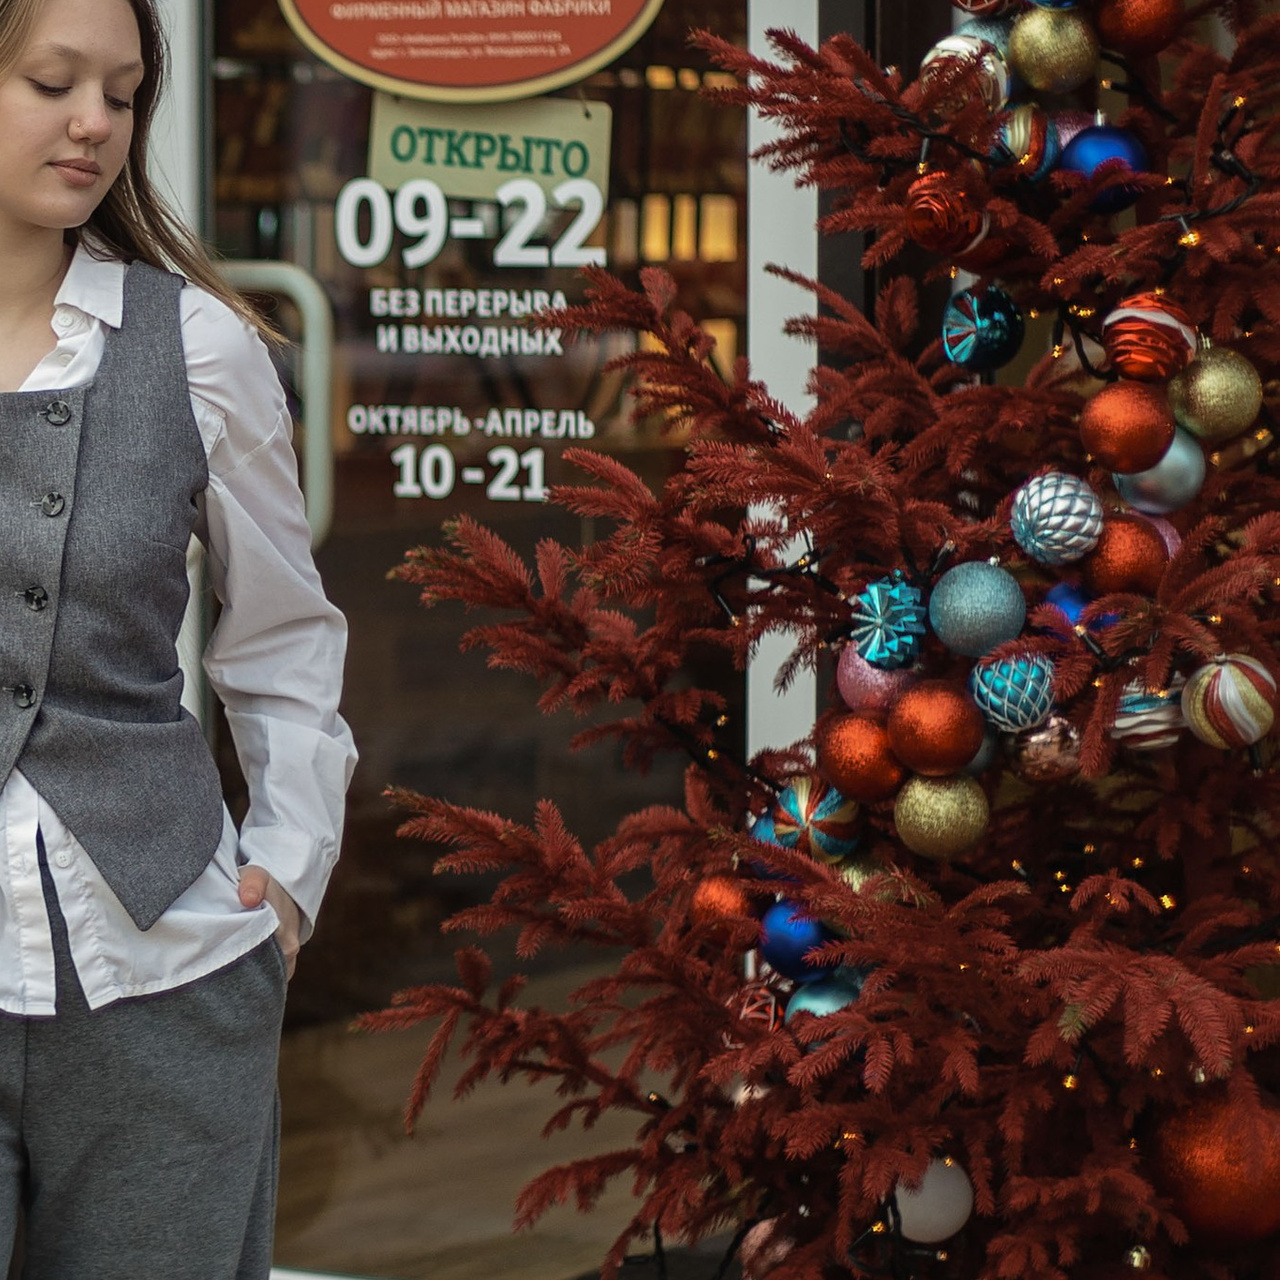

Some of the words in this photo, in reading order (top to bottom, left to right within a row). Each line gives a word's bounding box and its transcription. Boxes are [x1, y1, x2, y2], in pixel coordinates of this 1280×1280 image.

[389, 123, 591, 180] ОТКРЫТО
[335, 177, 607, 268] 09-22
[370, 287, 421, 317] БЕЗ
[376, 324, 399, 354] И
[402, 324, 564, 359] ВЫХОДНЫХ
